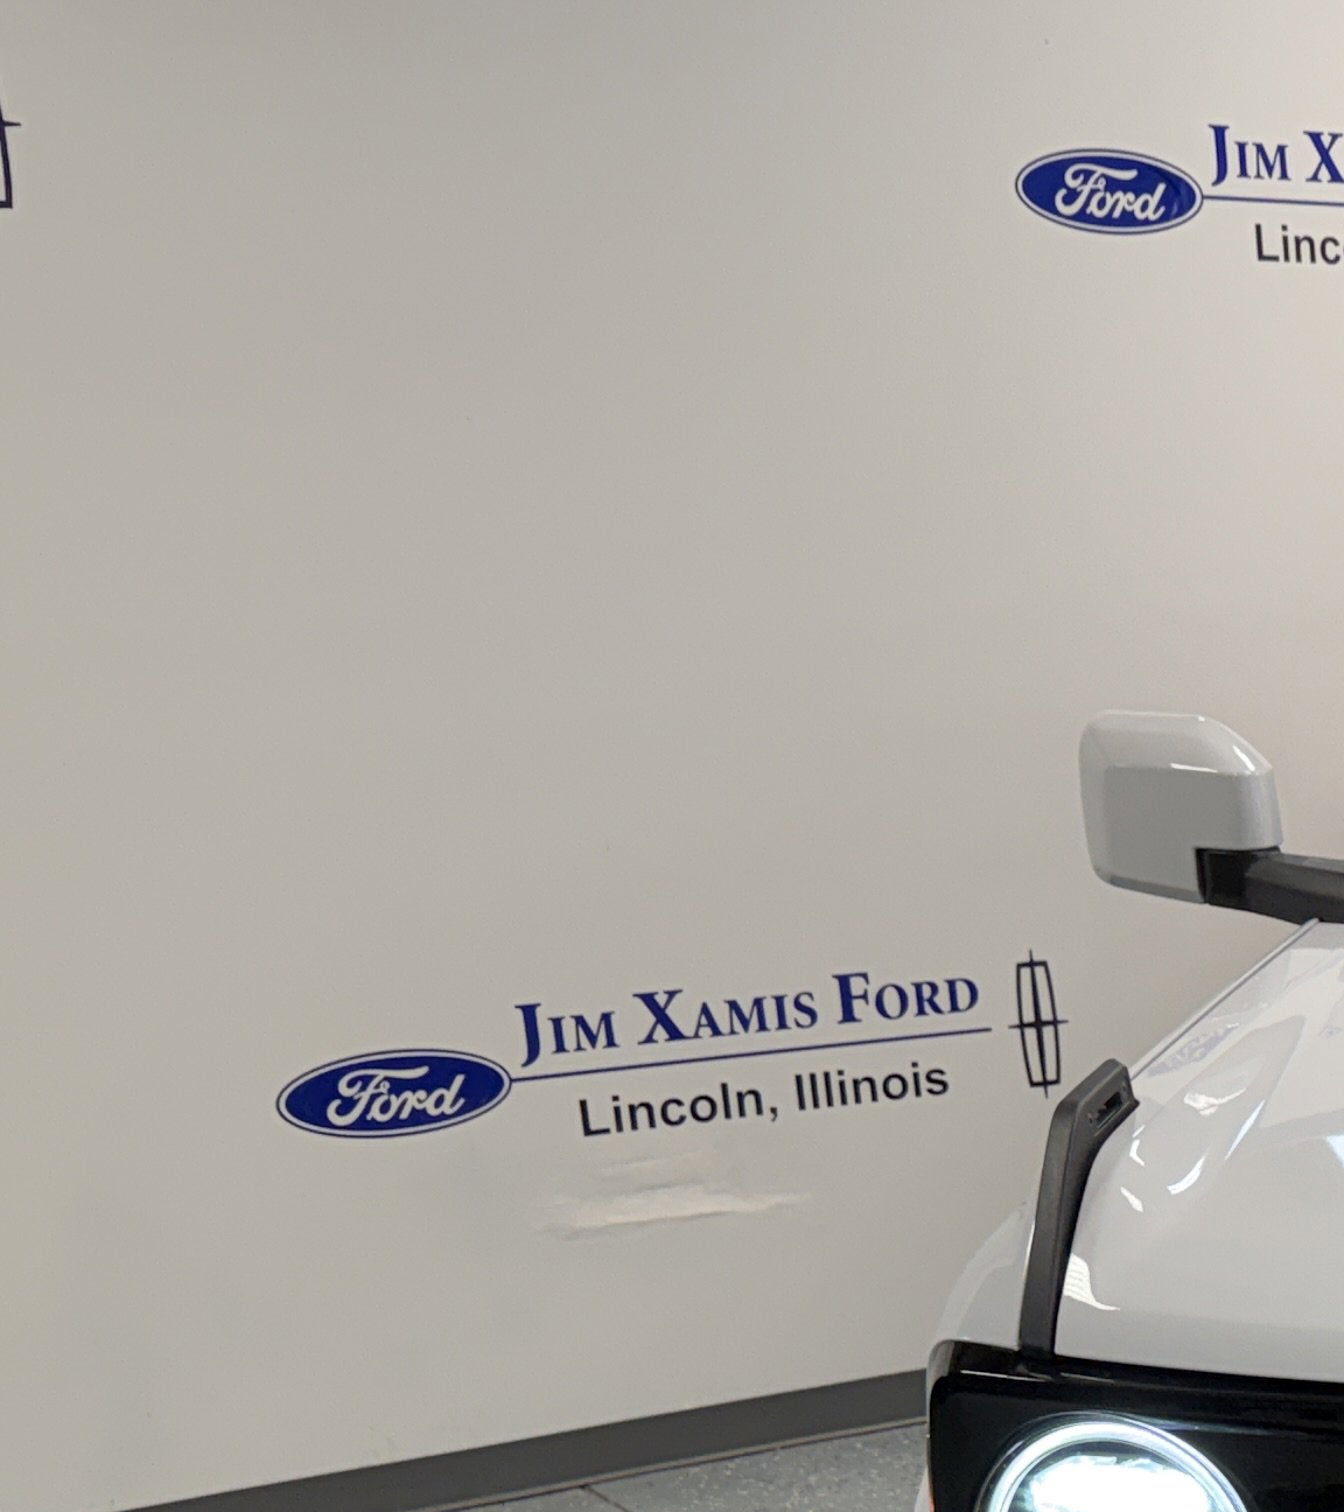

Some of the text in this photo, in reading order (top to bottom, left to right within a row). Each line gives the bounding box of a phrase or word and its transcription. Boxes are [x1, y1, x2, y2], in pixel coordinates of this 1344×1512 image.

[1208, 124, 1290, 187] JIM
[1055, 162, 1166, 222] Ford
[514, 972, 979, 1068] JIM XAMIS FORD
[326, 1064, 465, 1127] Ford
[578, 1062, 949, 1137] Lincoln, Illinois
